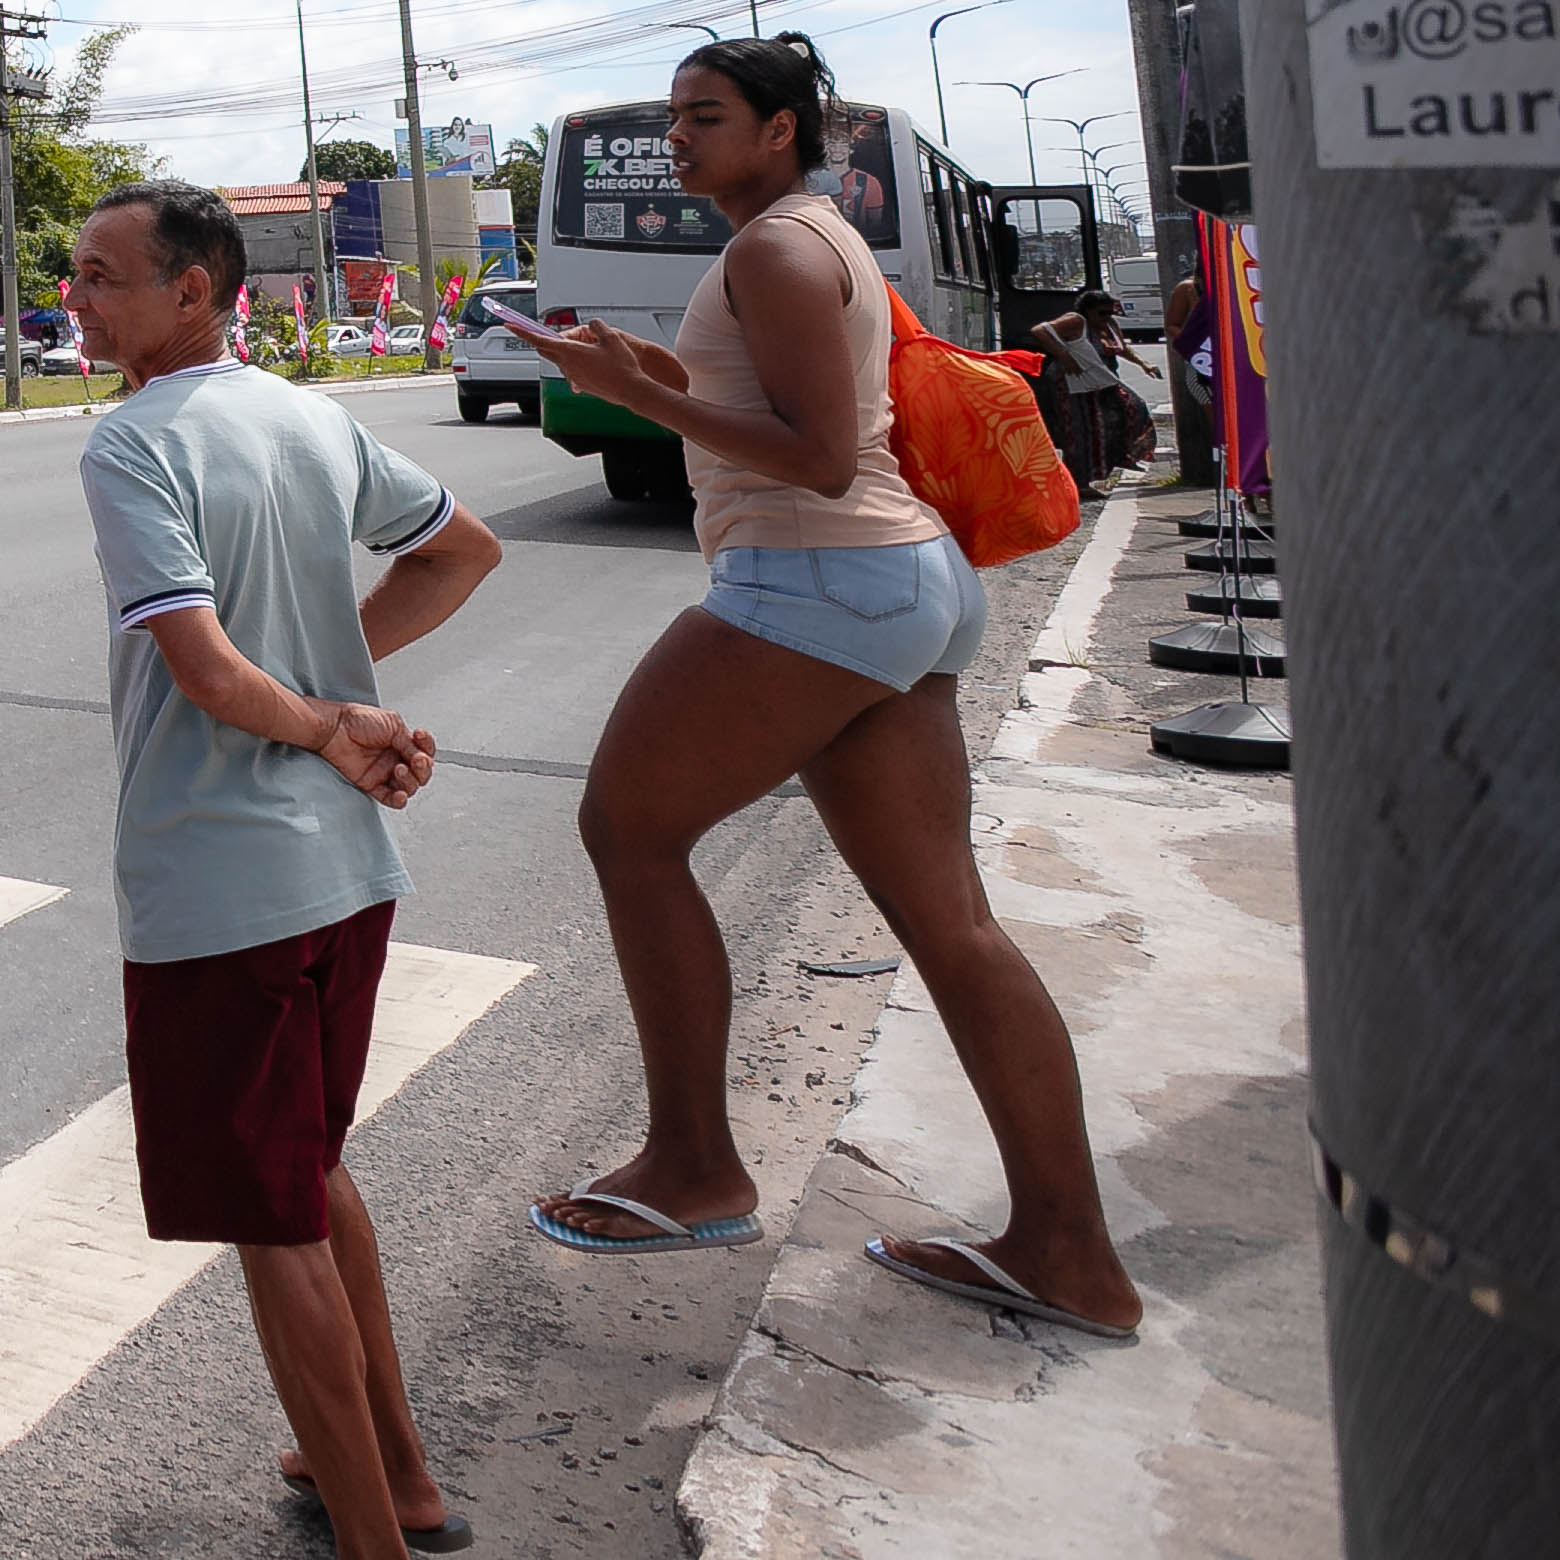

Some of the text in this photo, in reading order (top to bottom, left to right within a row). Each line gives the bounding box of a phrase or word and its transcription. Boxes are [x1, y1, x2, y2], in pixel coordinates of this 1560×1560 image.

[1362, 84, 1560, 140] Laur
[584, 135, 603, 157] É
[584, 178, 653, 190] CHEGOU
